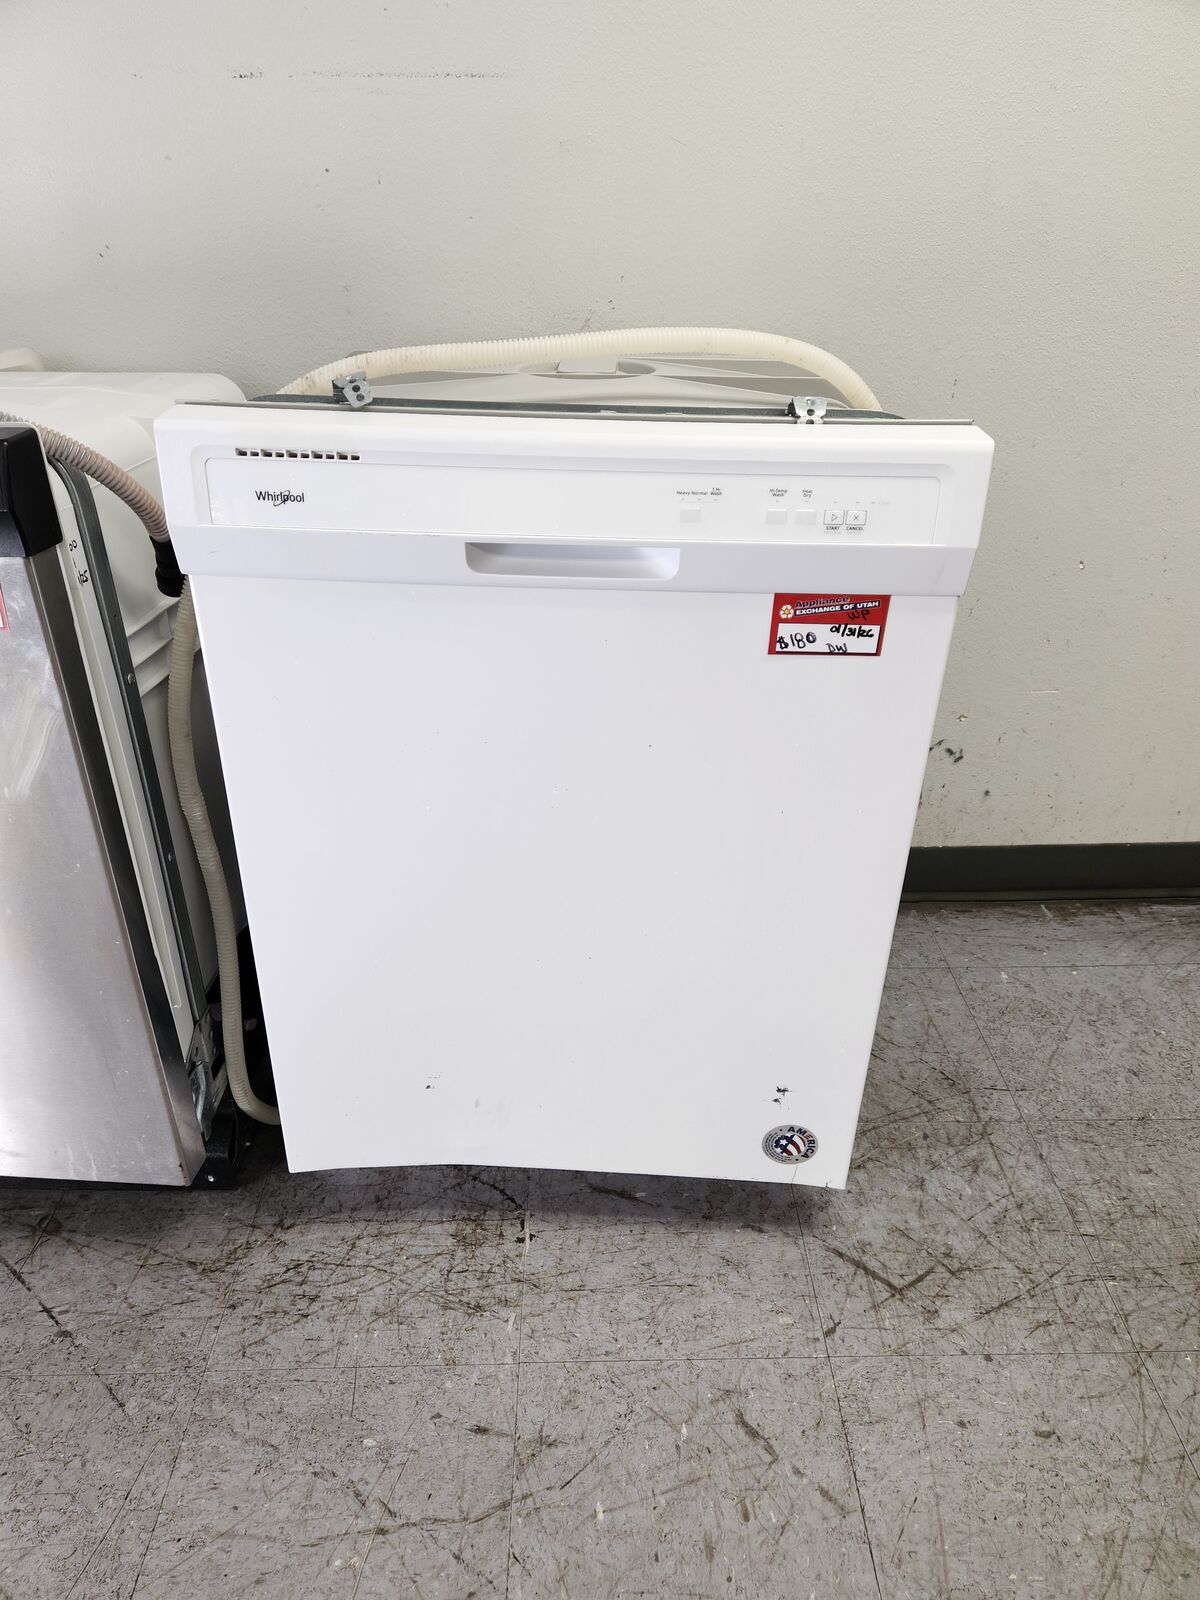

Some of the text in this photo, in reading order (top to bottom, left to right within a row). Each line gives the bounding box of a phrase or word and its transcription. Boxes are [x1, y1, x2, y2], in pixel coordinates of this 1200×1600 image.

[255, 490, 305, 506] Whirlpool
[796, 596, 850, 608] Appliance
[796, 605, 841, 615] EXCHANGE
[857, 600, 879, 608] UTAH
[776, 632, 817, 650] $180
[826, 642, 848, 653] DW
[787, 1126, 816, 1159] AMERICA
